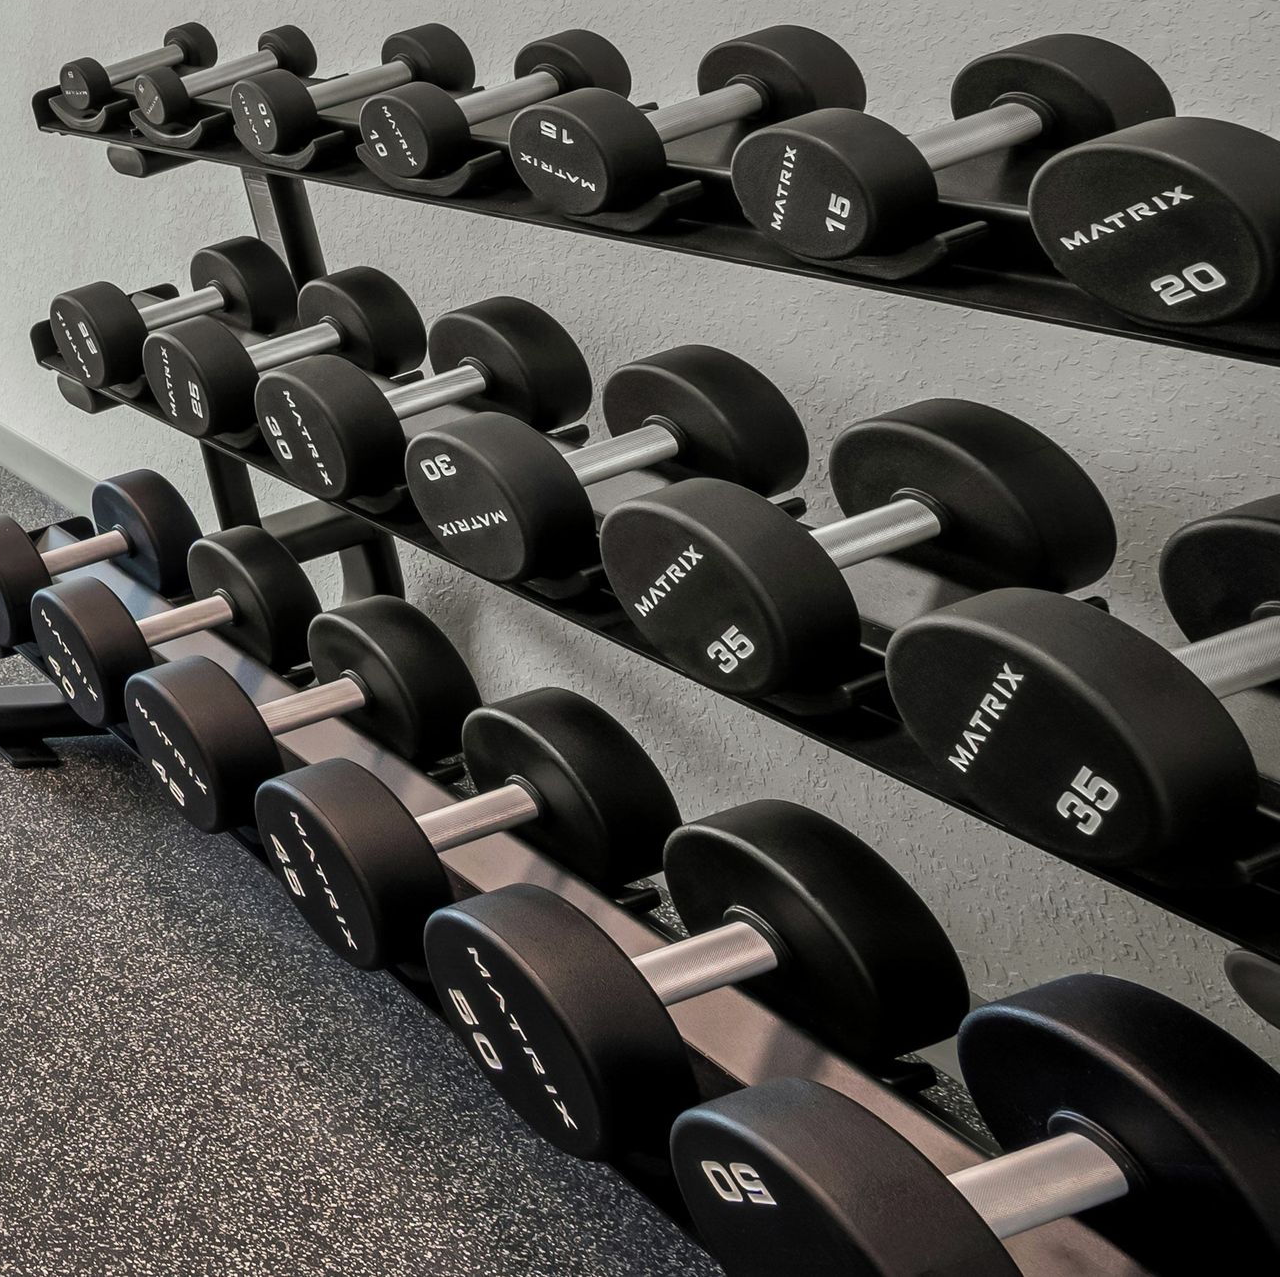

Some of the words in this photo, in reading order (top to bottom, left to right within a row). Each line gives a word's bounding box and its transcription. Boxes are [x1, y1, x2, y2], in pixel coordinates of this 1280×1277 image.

[238, 92, 262, 145] MATRIX
[258, 103, 271, 128] 10
[381, 106, 418, 167] MATRIX
[540, 121, 574, 144] 15
[370, 129, 388, 157] 10
[520, 152, 596, 191] MATRIX
[770, 145, 797, 231] MATRIX
[825, 193, 851, 232] 15
[1059, 185, 1194, 251] MATRIX
[1150, 262, 1227, 306] 20
[56, 311, 91, 378] MATRIX
[78, 322, 98, 355] 25
[160, 346, 178, 417] MATRIX
[188, 380, 204, 419] 25
[265, 416, 293, 460] 30
[283, 390, 333, 486] MATRIX
[420, 453, 457, 482] 30
[438, 510, 508, 537] MATRIX
[634, 544, 704, 617] MATRIX
[41, 609, 99, 701] MATRIX
[707, 625, 755, 674] 35
[48, 655, 76, 700] 40
[948, 663, 1025, 773] MATRIX
[135, 698, 208, 795] MATRIX
[151, 758, 185, 807] 45
[1056, 765, 1119, 836] 35
[270, 833, 306, 898] 45
[290, 811, 358, 951] MATRIX
[448, 987, 503, 1071] 50
[467, 947, 578, 1131] MATRIX
[701, 1160, 778, 1206] 50
